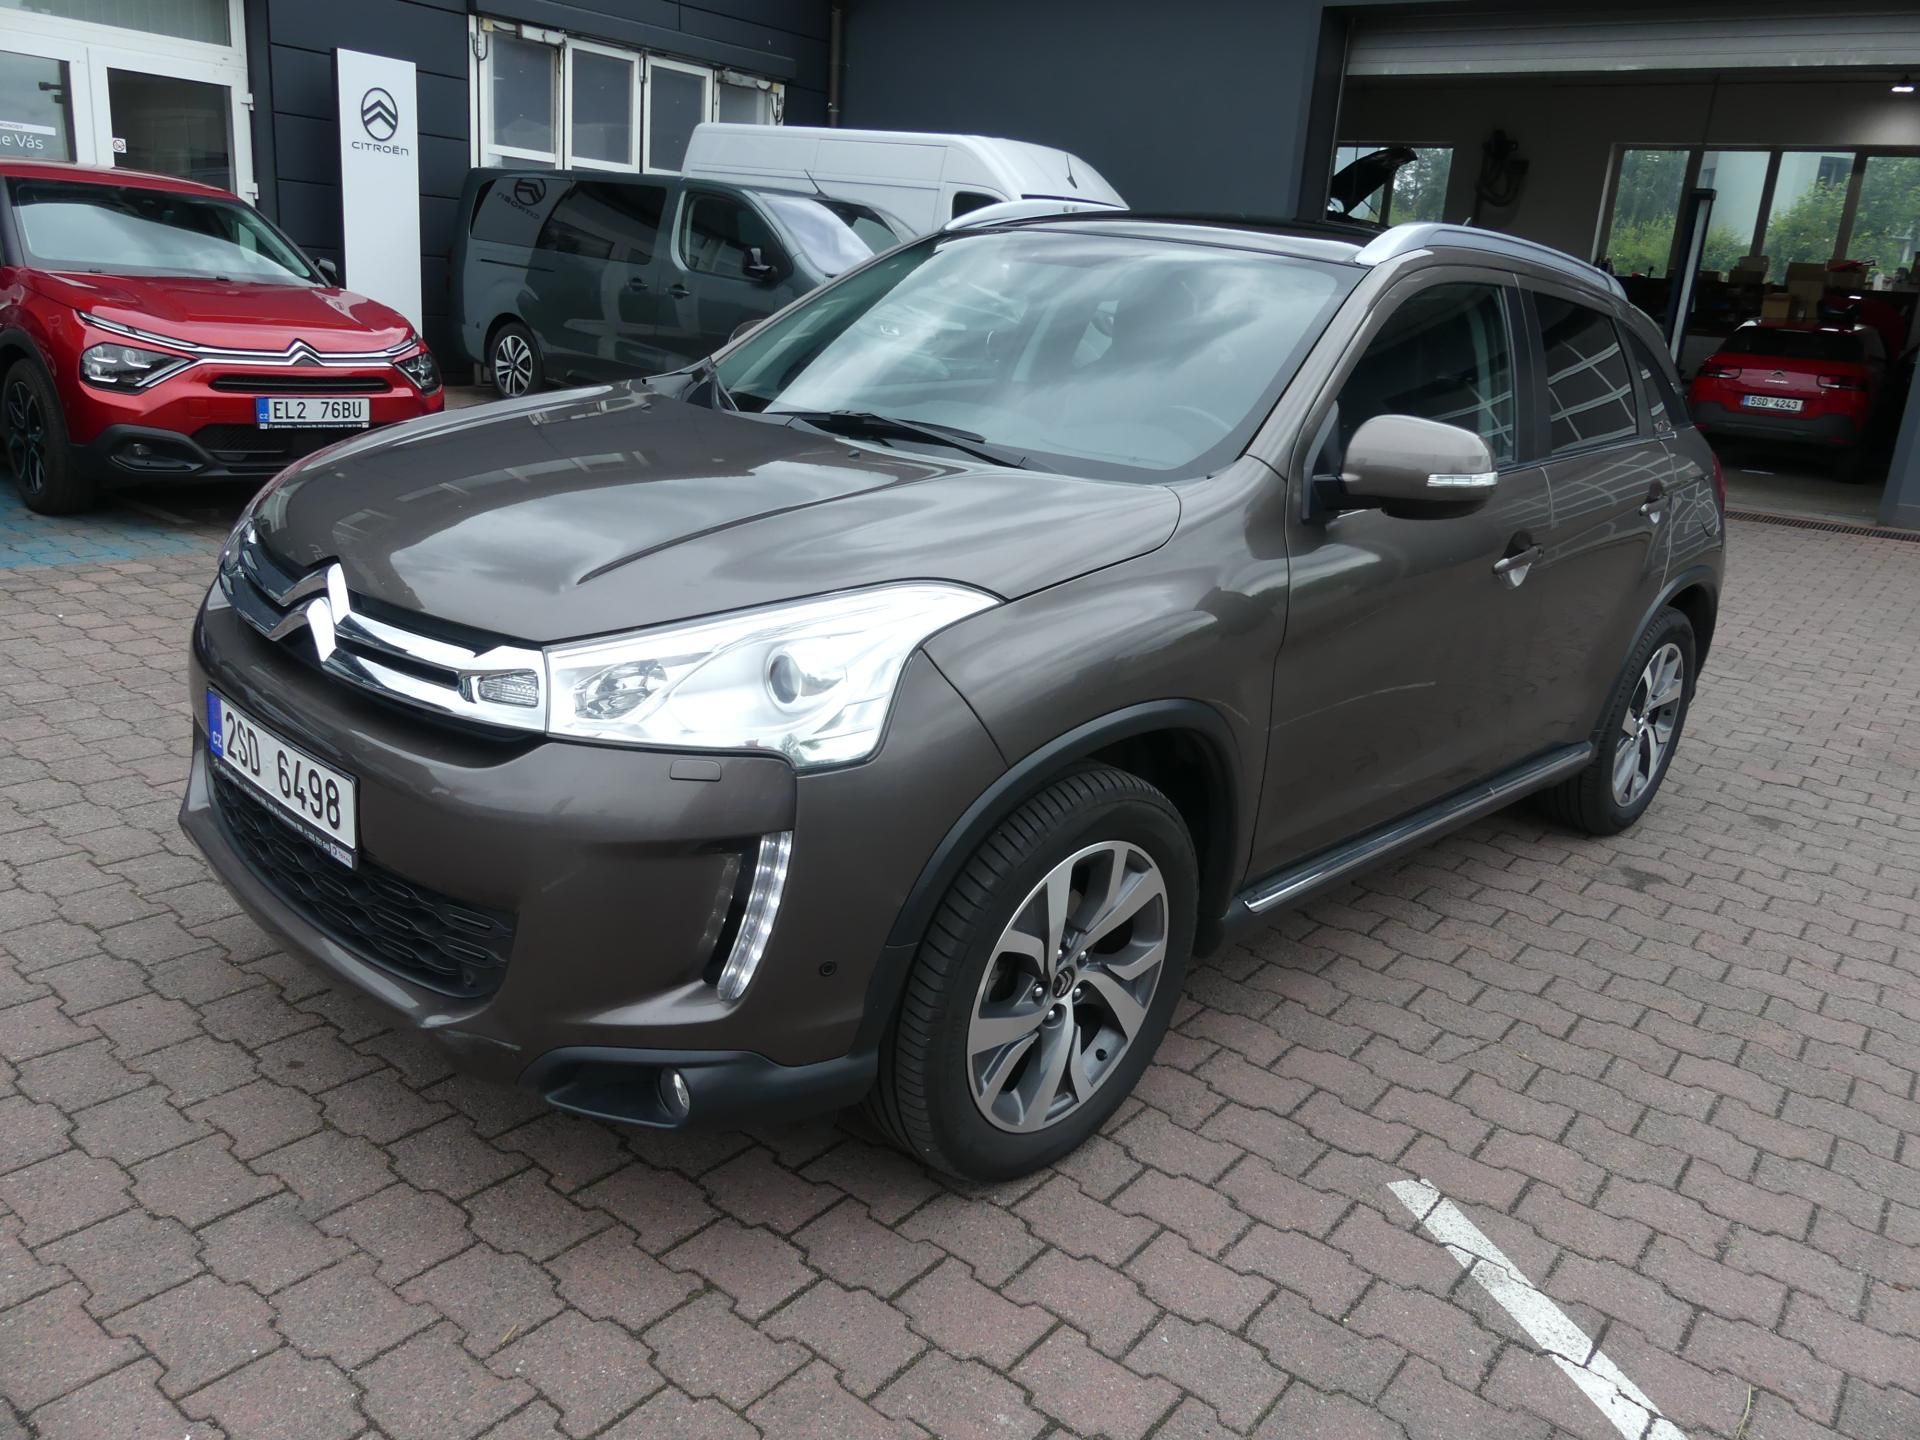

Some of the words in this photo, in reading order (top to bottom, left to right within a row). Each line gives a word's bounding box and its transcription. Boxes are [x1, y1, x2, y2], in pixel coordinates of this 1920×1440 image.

[0, 135, 11, 146] e
[14, 133, 44, 150] Vás
[273, 401, 307, 419] EL2
[320, 401, 362, 419] 76BU
[1774, 399, 1798, 409] 4243
[212, 731, 223, 748] CZ
[225, 711, 261, 777] 2SD
[277, 749, 341, 830] 6498
